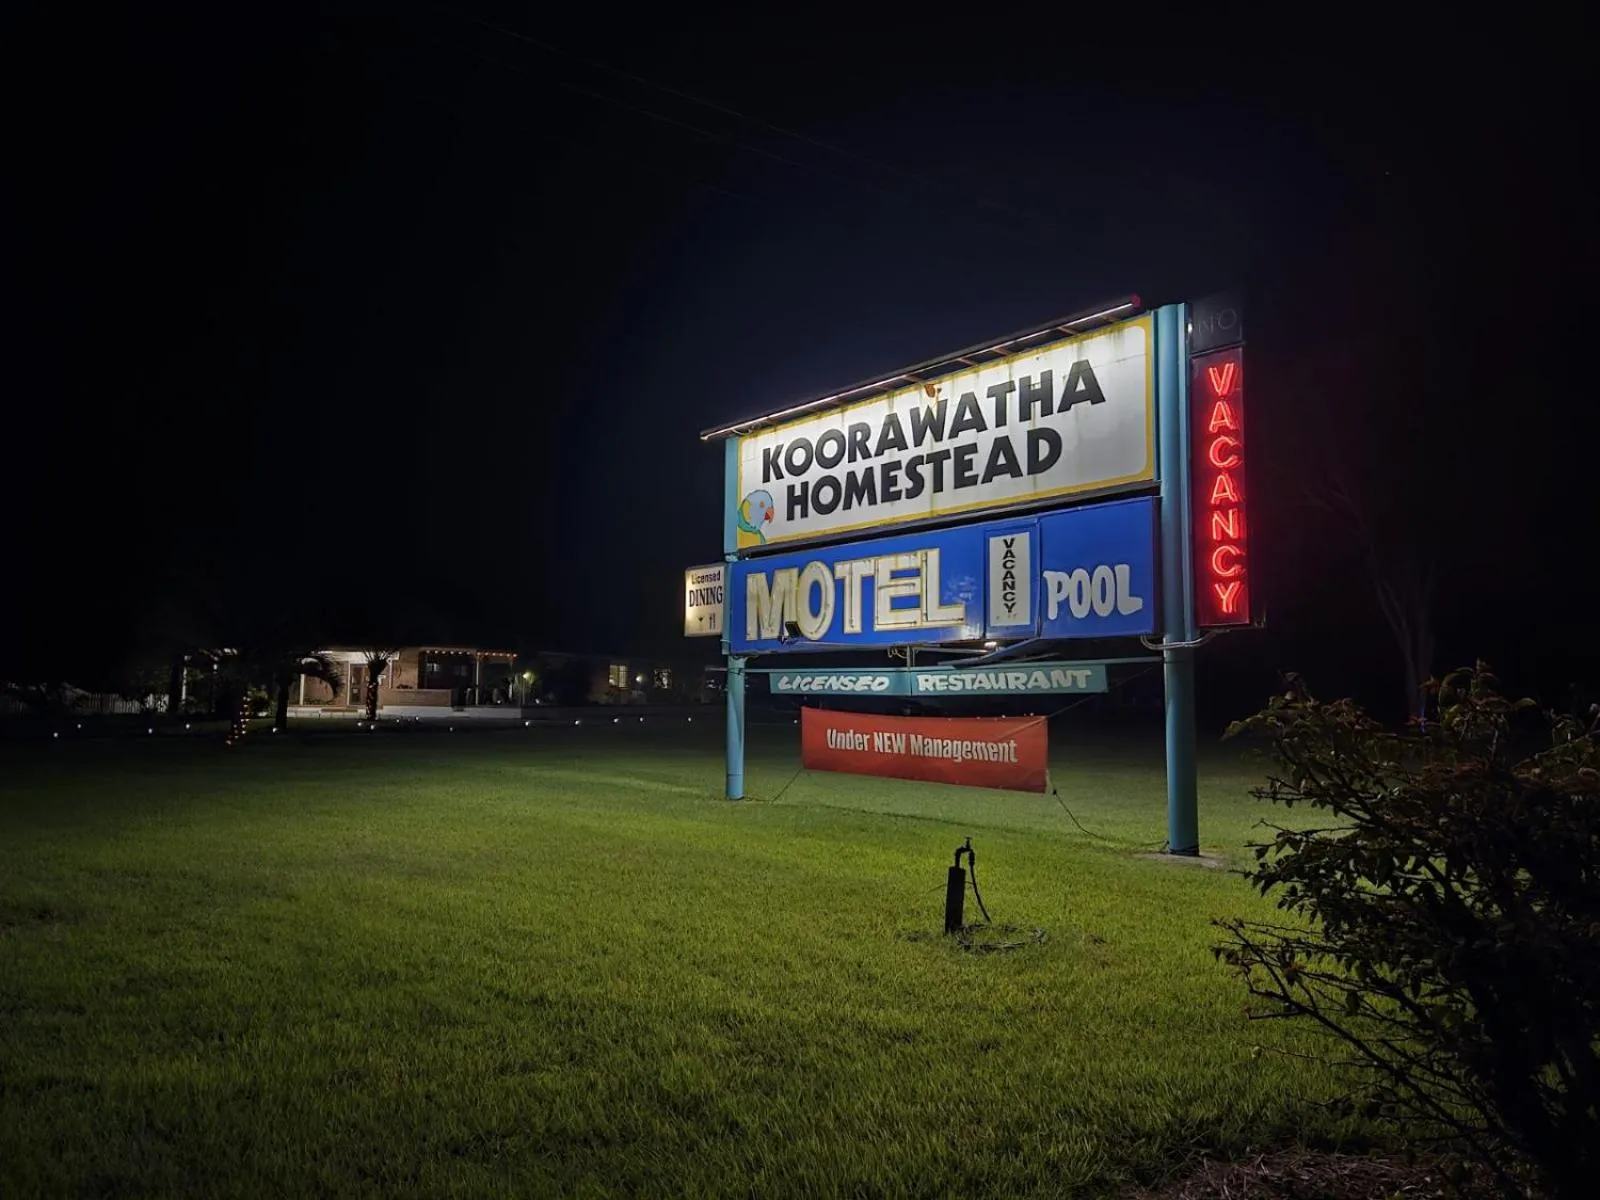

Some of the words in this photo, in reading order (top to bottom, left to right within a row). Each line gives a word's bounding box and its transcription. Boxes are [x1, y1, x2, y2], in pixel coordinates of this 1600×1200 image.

[1197, 308, 1237, 334] NO
[762, 359, 1105, 483] KOORAWATHA
[786, 428, 1063, 521] HOMESTEAD
[1208, 362, 1245, 613] VACANCY
[689, 586, 723, 607] DINING
[691, 570, 721, 585] Licensed
[746, 549, 966, 641] MOTEL
[1003, 538, 1016, 613] VACANCY
[1043, 564, 1143, 620] POOL
[777, 675, 890, 692] LICENSED
[916, 670, 1092, 692] RESTAURANT
[827, 728, 870, 752] Under
[874, 733, 906, 754] NEW
[910, 735, 1018, 763] Management
